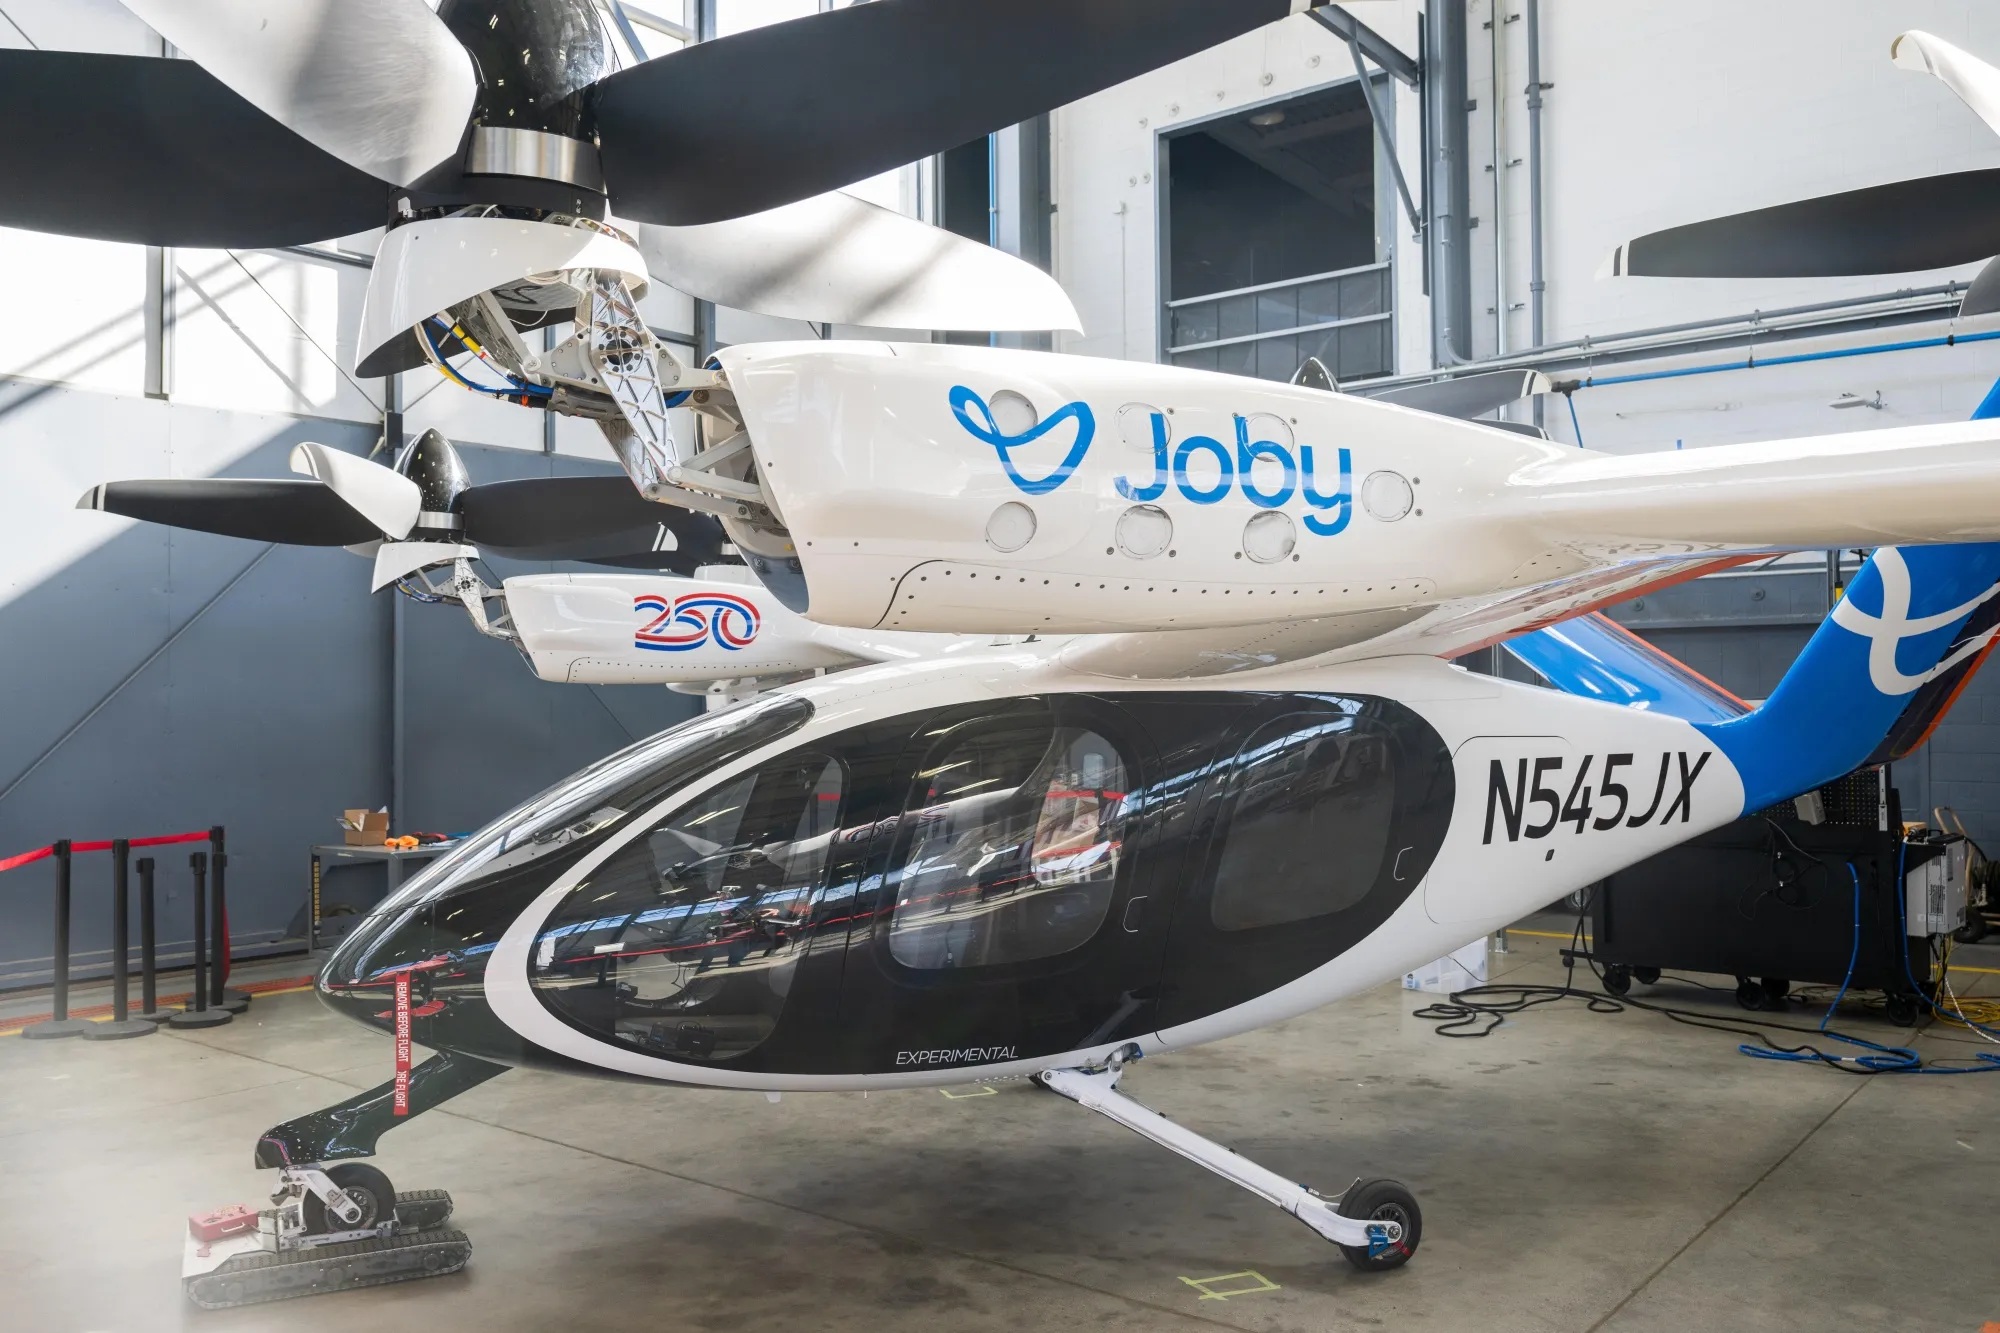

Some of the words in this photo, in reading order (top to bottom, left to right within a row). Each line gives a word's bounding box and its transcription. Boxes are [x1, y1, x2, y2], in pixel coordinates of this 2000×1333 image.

[1113, 412, 1353, 537] Joby
[634, 592, 761, 652] 250
[1482, 751, 1713, 845] N545JX
[396, 981, 408, 1010] REMOVE
[397, 1011, 409, 1038] BEFORE
[398, 1039, 409, 1062] FLIGHT
[896, 1046, 1019, 1065] EXPERIMENTAL
[395, 1084, 406, 1108] FLIGHT
